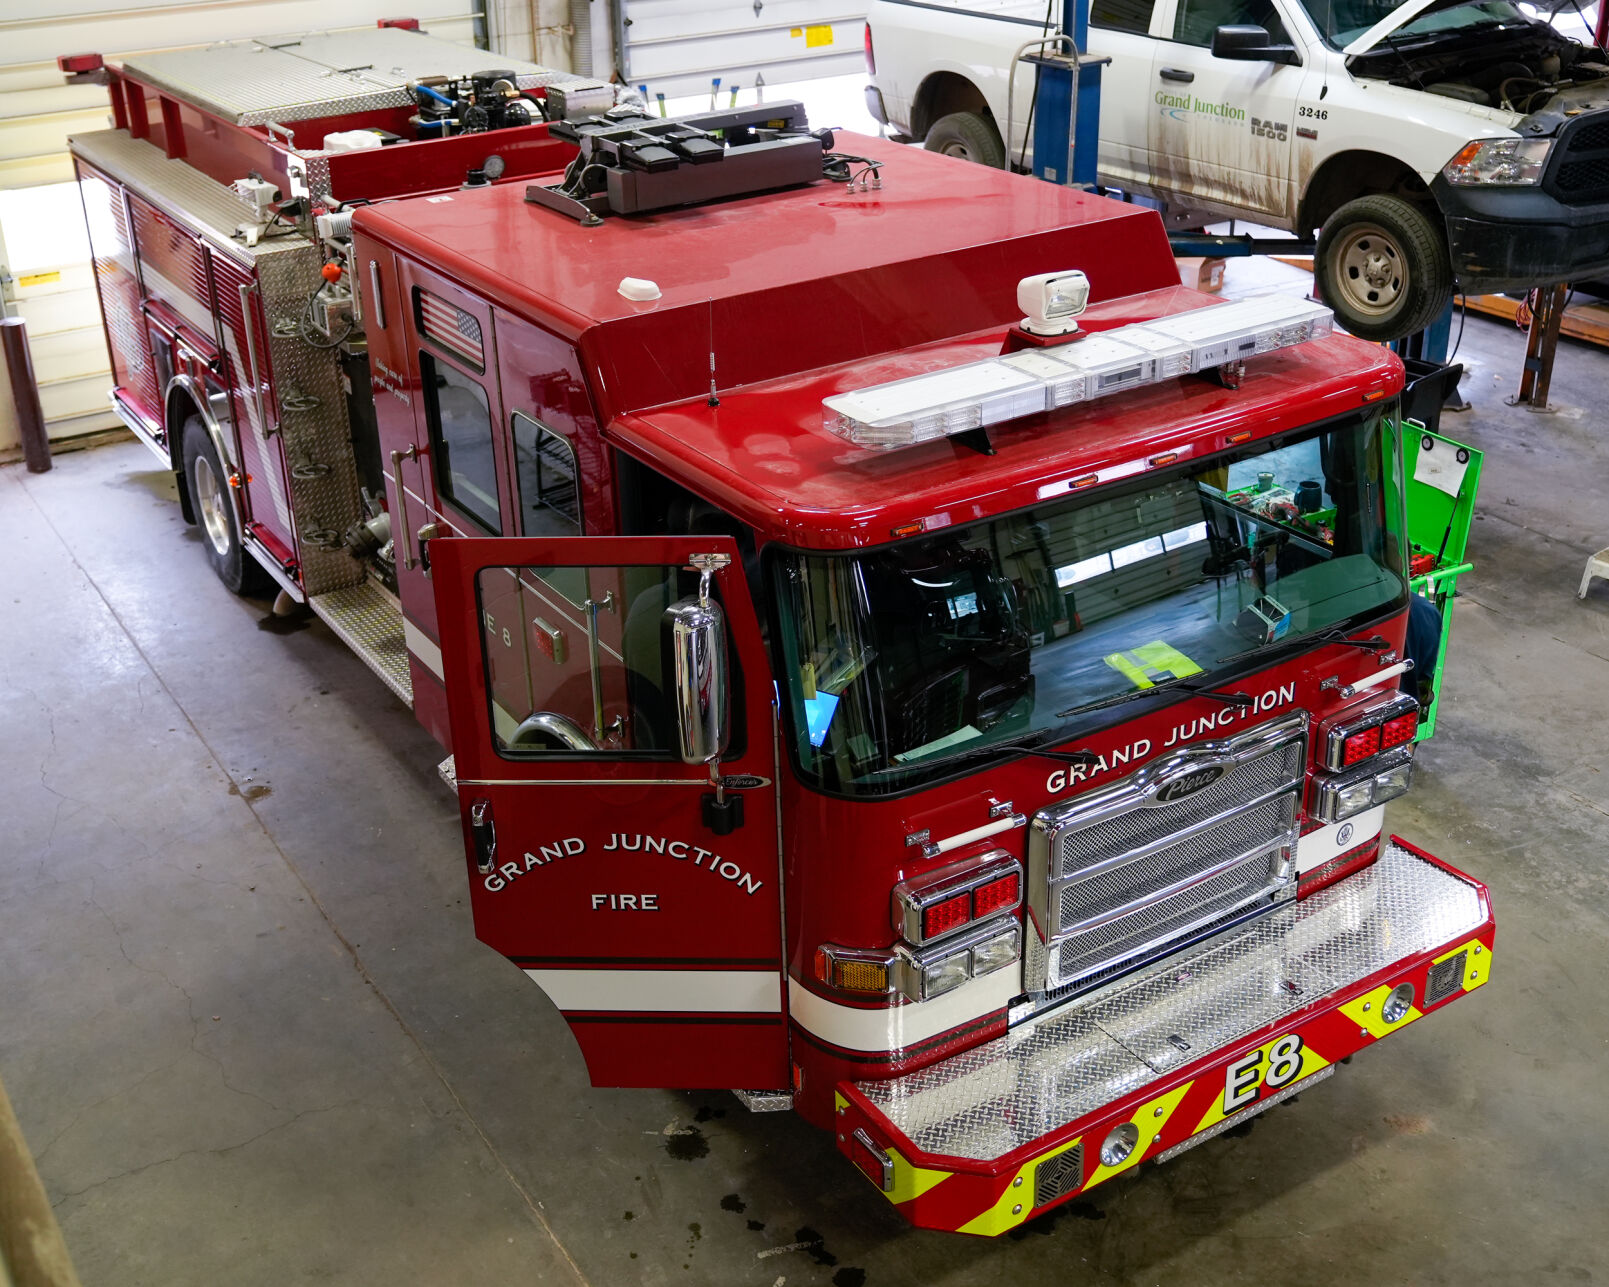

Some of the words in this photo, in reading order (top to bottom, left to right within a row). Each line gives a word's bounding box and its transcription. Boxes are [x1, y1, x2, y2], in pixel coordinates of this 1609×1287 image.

[1154, 90, 1191, 110] Grand
[1194, 95, 1245, 121] Junction
[1298, 106, 1328, 121] 3246
[1251, 116, 1288, 133] RAM
[1251, 127, 1288, 142] 1500
[503, 627, 512, 647] 8
[1046, 738, 1152, 794] GRAND
[1166, 769, 1217, 800] Pierce
[483, 836, 587, 893] GRAND
[603, 833, 764, 896] JUNCTION
[591, 894, 660, 911] FIRE
[1223, 1033, 1304, 1116] E8
